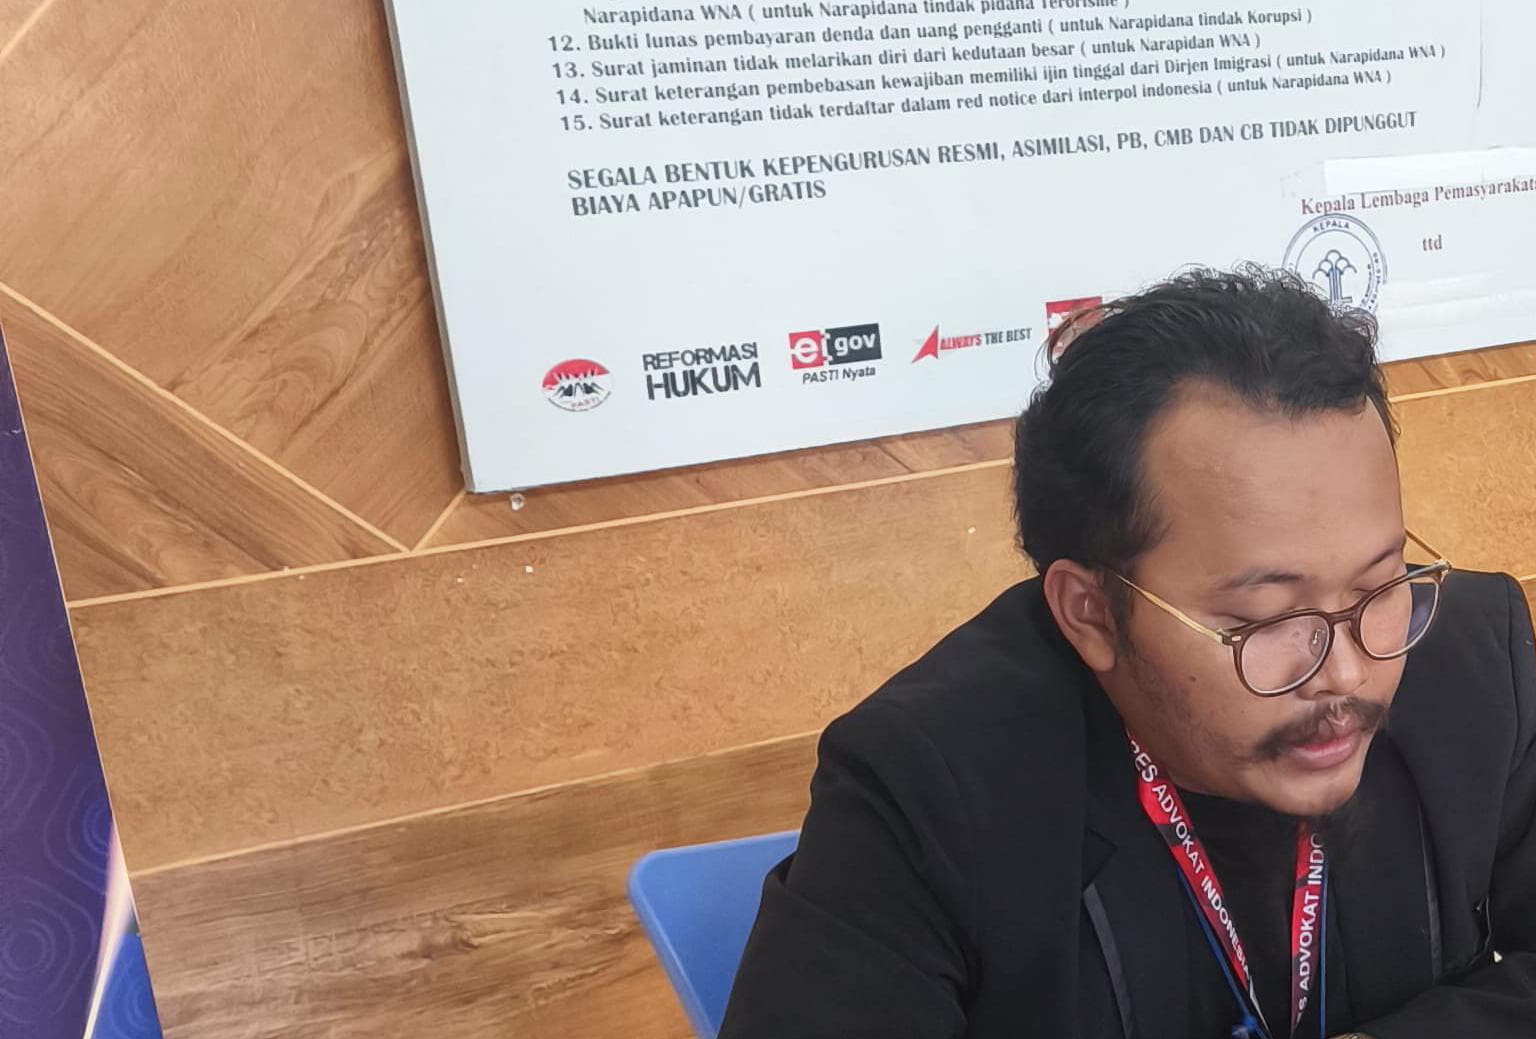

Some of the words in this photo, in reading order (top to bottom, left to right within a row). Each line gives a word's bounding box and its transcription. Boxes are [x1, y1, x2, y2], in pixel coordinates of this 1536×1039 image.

[548, 35, 581, 51] 12.
[587, 33, 639, 51] Bukti
[645, 32, 698, 48] lunas
[705, 28, 816, 49] pembayaran
[822, 25, 874, 42] denda
[880, 23, 911, 40] dan
[917, 23, 958, 40] uang
[963, 18, 1043, 38] pengganti
[1060, 16, 1104, 33] untuk
[1108, 12, 1194, 31] Narapidana
[1198, 10, 1243, 27] tindak
[1247, 9, 1302, 26] Korupsi
[583, 7, 696, 25] Narapidana
[700, 4, 742, 20] WNA
[762, 2, 814, 19] untuk
[818, 0, 919, 18] Narapidana
[923, 0, 976, 13] tindak
[552, 62, 585, 78] 13.
[591, 60, 644, 78] Surat
[651, 57, 727, 78] jaminan
[733, 55, 779, 71] tidak
[785, 49, 873, 69] melarikan
[878, 46, 907, 65] diri
[913, 45, 946, 63] dari
[952, 42, 1026, 61] kedutaan
[1031, 40, 1075, 57] besar
[1092, 38, 1136, 55] untuk
[1140, 34, 1215, 53] Narapidan
[1219, 33, 1251, 47] WNA
[556, 89, 589, 105] 14.
[595, 86, 648, 104] Surat
[655, 82, 760, 101] keterangan
[766, 75, 876, 99] pembebasan
[881, 69, 963, 90] kewajiban
[970, 66, 1038, 85] memiliki
[1043, 64, 1068, 83] ijin
[1073, 61, 1125, 81] tinggal
[1130, 58, 1159, 75] dari
[1164, 57, 1209, 75] Dirjen
[1214, 55, 1272, 72] Imigrasi
[1286, 49, 1326, 66] untuk
[1330, 47, 1405, 65] Narapidana
[1408, 45, 1437, 58] WNA
[560, 115, 593, 131] 15.
[599, 113, 651, 130] Surat
[658, 107, 763, 126] keterangan
[769, 103, 815, 121] tidak
[820, 97, 895, 117] terdaftar
[901, 93, 951, 112] dalam
[956, 92, 983, 109] red
[989, 90, 1037, 106] notice
[1042, 88, 1073, 104] dari
[1078, 85, 1137, 104] interpol
[1142, 80, 1213, 98] indonesia
[1228, 77, 1268, 93] untuk
[1272, 73, 1350, 91] Narapidana
[1353, 71, 1382, 84] WNA
[567, 167, 657, 190] SEGALA
[664, 159, 755, 183] BENTUK
[762, 147, 931, 178] KEPENGURUSAN
[938, 140, 1006, 166] RESMI,
[1012, 133, 1110, 161] ASIMILASI,
[1117, 129, 1149, 153] PB,
[1154, 126, 1194, 147] CMB
[1199, 123, 1235, 143] DAN
[1239, 120, 1265, 141] CB
[1269, 115, 1320, 138] TIDAK
[1325, 110, 1417, 135] DIPUNGGUT
[571, 193, 641, 217] BIAYA
[648, 179, 827, 210] APAPUN/GRATIS
[1301, 195, 1356, 215] Kepala
[1361, 190, 1430, 210] Lembaga
[1312, 220, 1350, 232] KEPALA
[1422, 235, 1442, 251] ttd
[642, 342, 759, 371] REFORMASI
[940, 333, 982, 350] ALWAYS
[984, 332, 1004, 345] THE
[1006, 328, 1032, 342] BEST
[646, 362, 762, 400] HUKUM
[842, 366, 876, 382] Nyata
[1152, 784, 1205, 874] ADVOKAT
[1299, 890, 1320, 991] ADVOKAT
